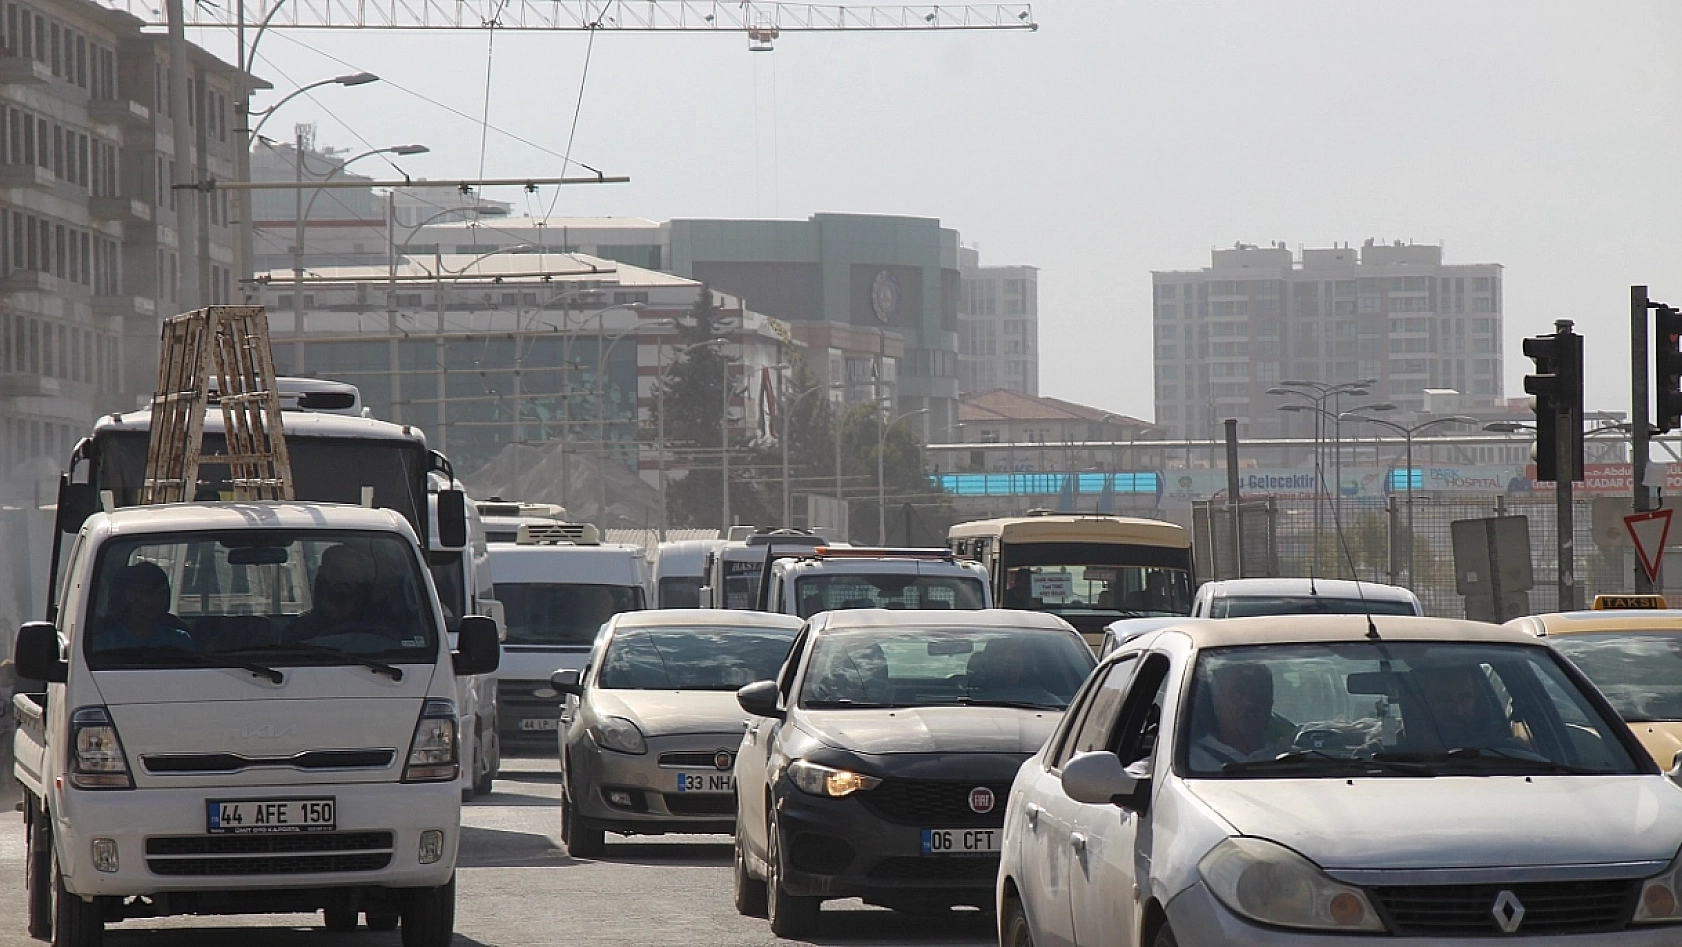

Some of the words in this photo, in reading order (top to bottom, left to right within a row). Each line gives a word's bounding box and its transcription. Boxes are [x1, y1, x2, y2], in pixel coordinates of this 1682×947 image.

[1430, 468, 1459, 478] PARK
[1249, 474, 1315, 489] Gelecektir
[1445, 474, 1503, 488] HOSPITAL
[1585, 478, 1625, 488] KADAR
[686, 775, 703, 790] 33
[974, 794, 989, 806] FIAT
[221, 805, 243, 824] 44
[255, 804, 288, 824] AFE
[301, 803, 332, 823] 150
[932, 831, 952, 850] 06
[964, 831, 994, 850] CFT
